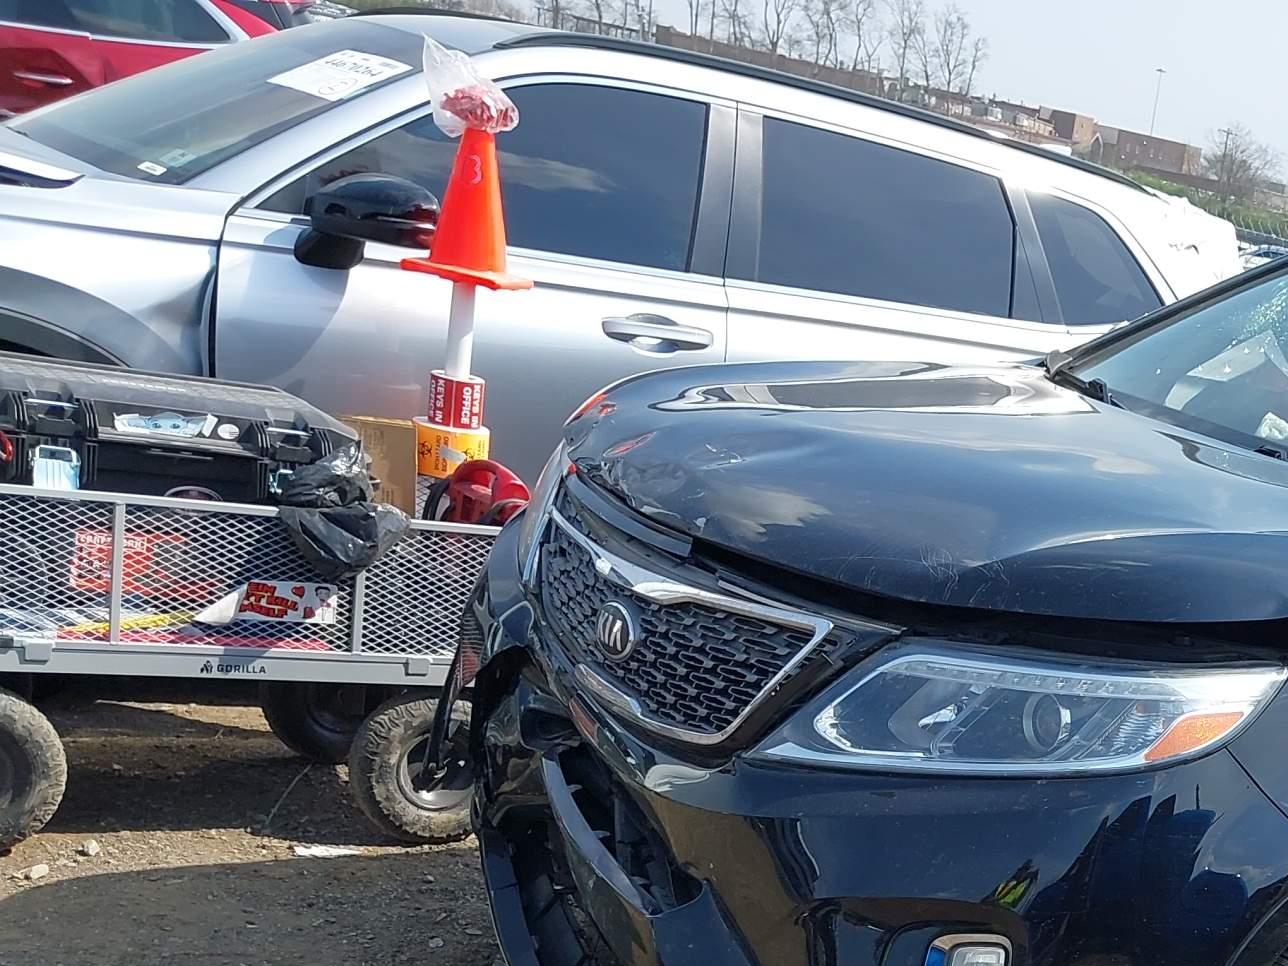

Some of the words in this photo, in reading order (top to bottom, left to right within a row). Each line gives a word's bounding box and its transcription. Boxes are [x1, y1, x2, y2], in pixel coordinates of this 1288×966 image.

[436, 379, 445, 408] KEYS
[472, 385, 481, 414] KEYS
[461, 387, 472, 425] OFFICE
[435, 411, 443, 423] IN
[471, 416, 479, 428] IN
[217, 664, 267, 674] GORILLA
